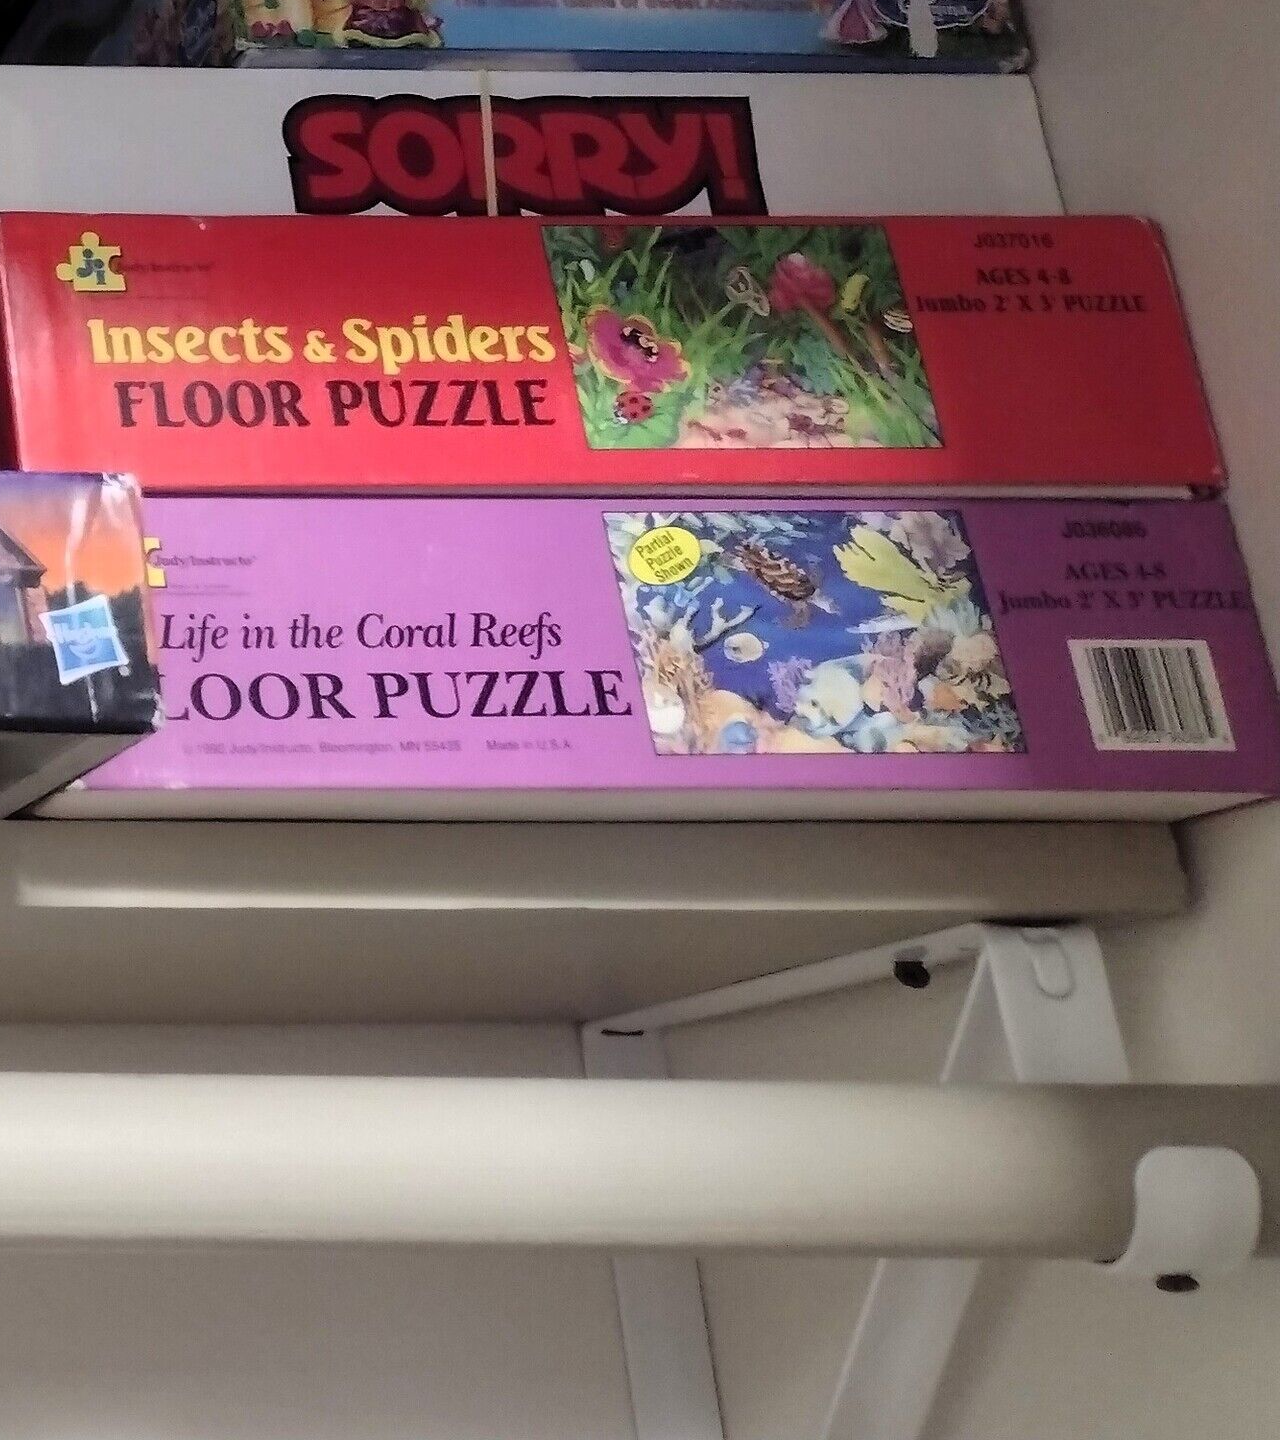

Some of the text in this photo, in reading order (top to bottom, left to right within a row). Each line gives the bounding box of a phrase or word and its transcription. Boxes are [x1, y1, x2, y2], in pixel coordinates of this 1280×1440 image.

[292, 102, 758, 208] SORRY!
[1063, 295, 1147, 312] PUZZLE
[87, 314, 556, 376] Insects & Spiders
[113, 377, 557, 429] FLOOR PUZZLE
[635, 530, 674, 559] Partial
[645, 545, 683, 571] Puzzle
[654, 557, 694, 582] Shown
[159, 612, 230, 663] Life
[241, 613, 276, 649] in
[290, 613, 344, 649] the
[356, 612, 457, 650] Coral
[470, 612, 563, 660] Reefs
[366, 669, 633, 719] PUZZLE
